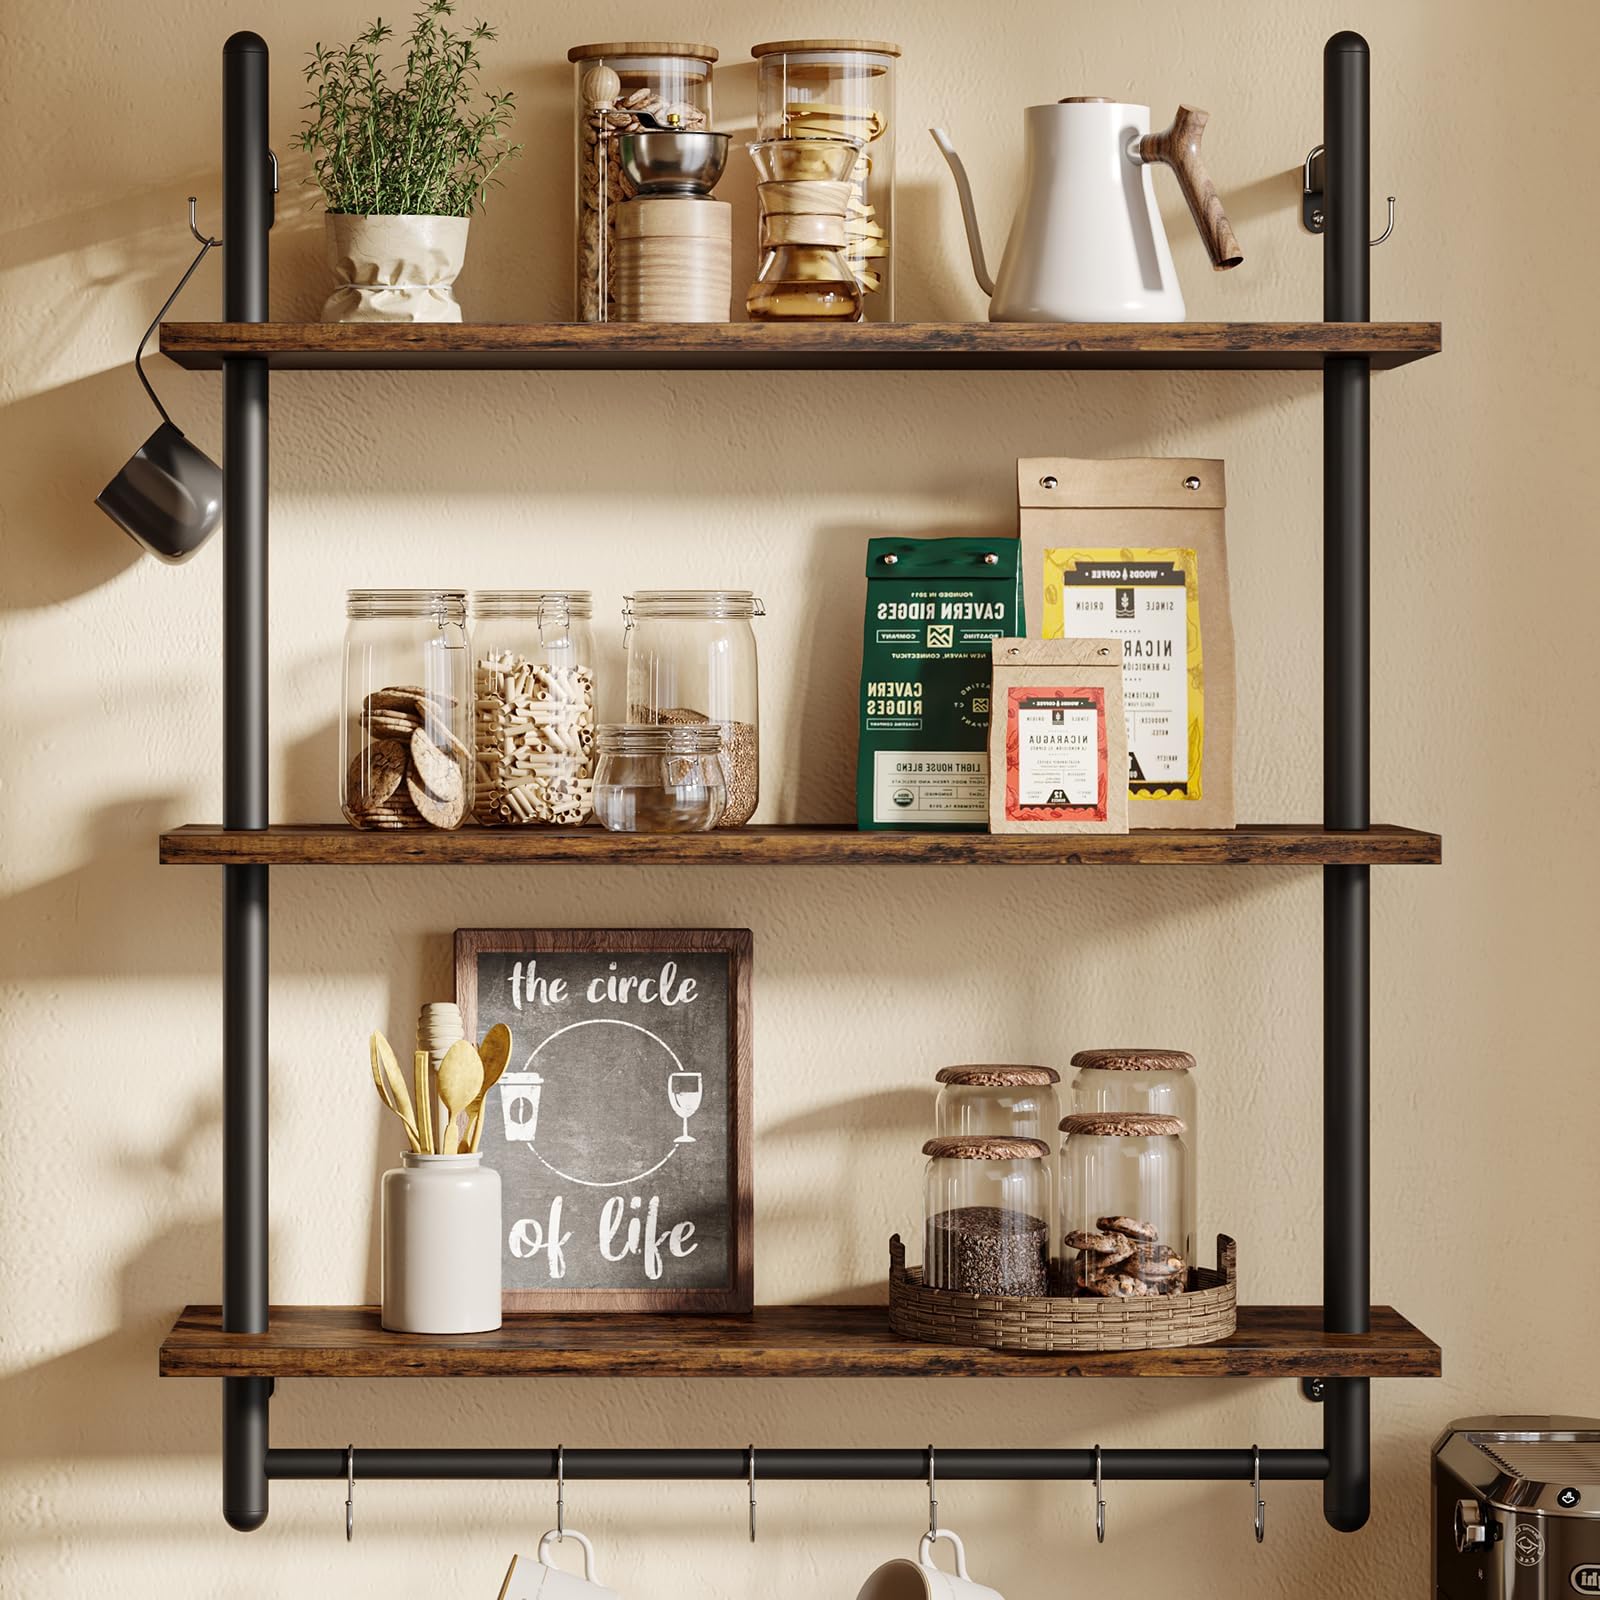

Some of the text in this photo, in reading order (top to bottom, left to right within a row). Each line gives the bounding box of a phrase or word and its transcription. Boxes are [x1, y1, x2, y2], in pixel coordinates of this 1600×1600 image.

[507, 959, 699, 1011] the circle
[508, 1195, 699, 1280] of life
